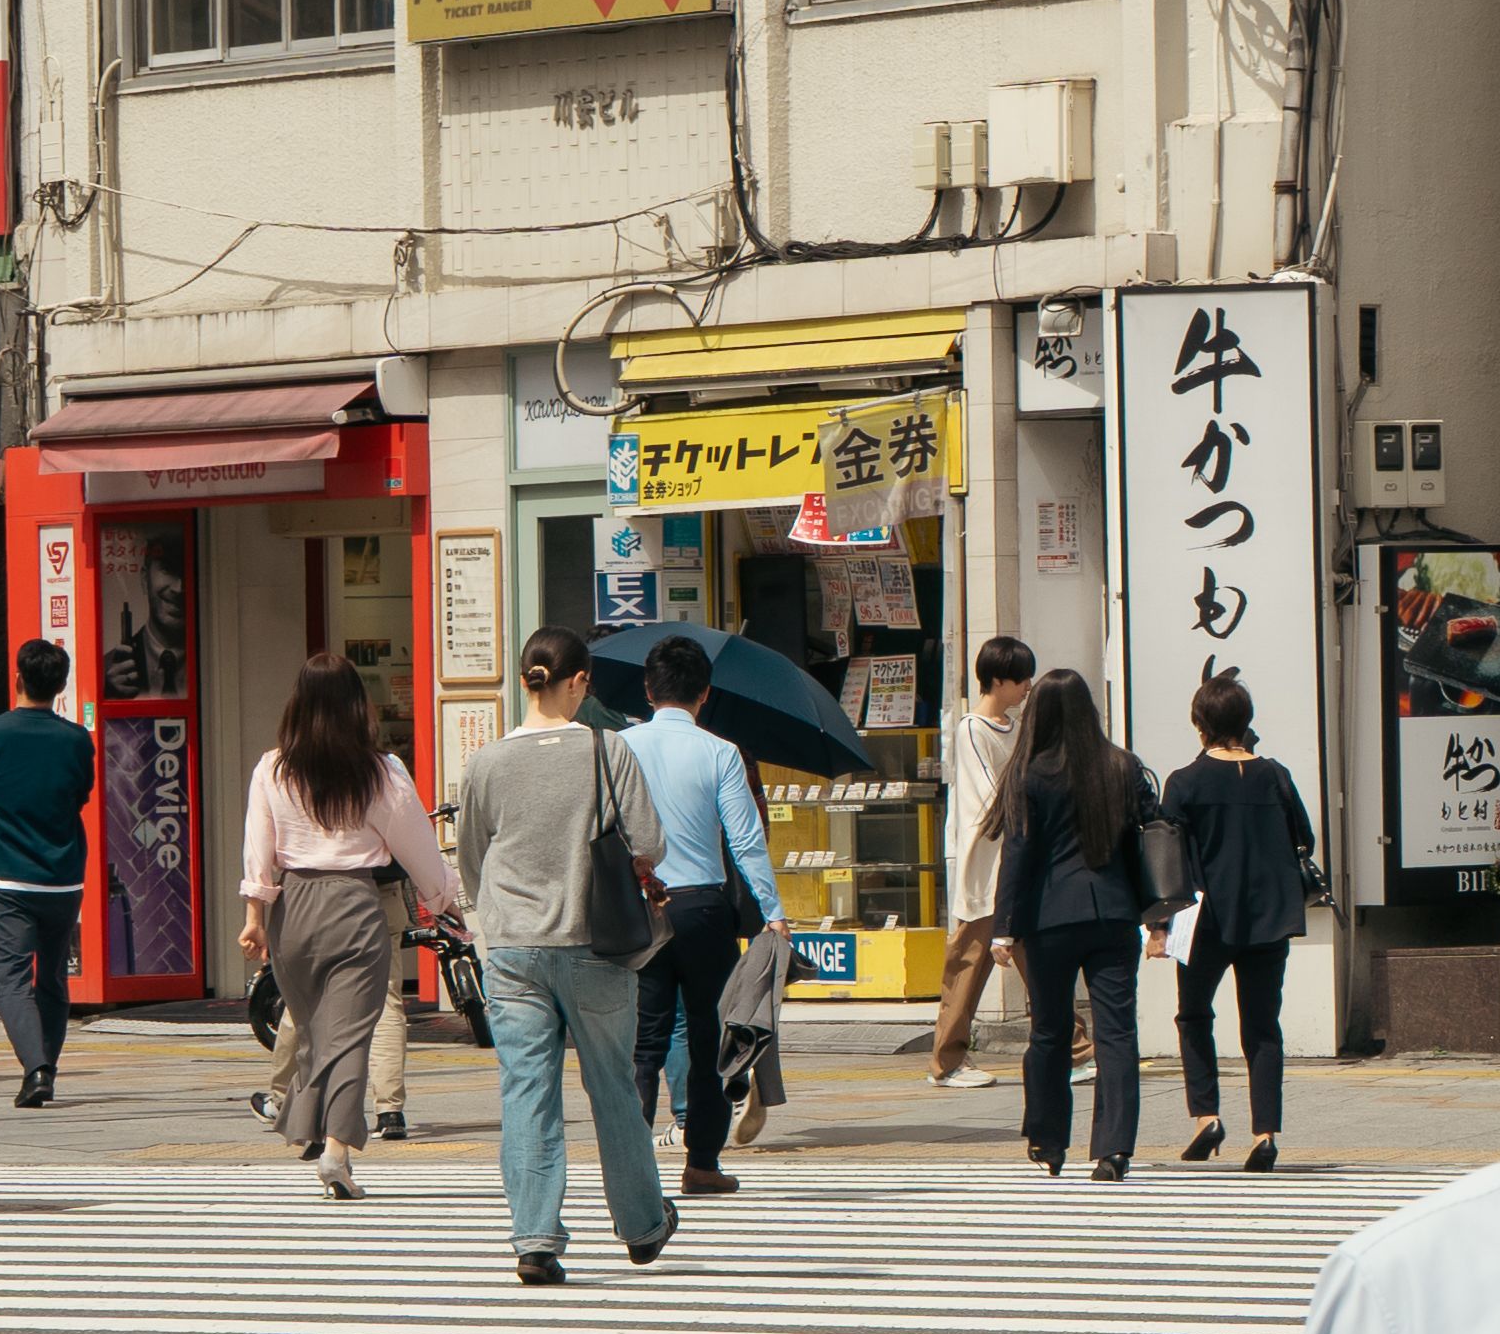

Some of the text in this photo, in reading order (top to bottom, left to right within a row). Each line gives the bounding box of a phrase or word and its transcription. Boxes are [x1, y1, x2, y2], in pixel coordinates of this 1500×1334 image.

[444, 0, 532, 19] TICKET RANGER
[553, 89, 640, 129] 川安ビル
[833, 413, 938, 491] 金券
[168, 462, 267, 489] vapestudio
[643, 477, 703, 500] 金券ショップ
[52, 597, 67, 609] TAX
[606, 573, 646, 626] EX
[52, 609, 67, 618] FREE
[860, 604, 883, 620] 96.5
[873, 660, 913, 678] マクドナルド
[154, 718, 189, 870] Device
[1441, 799, 1488, 821] もと村
